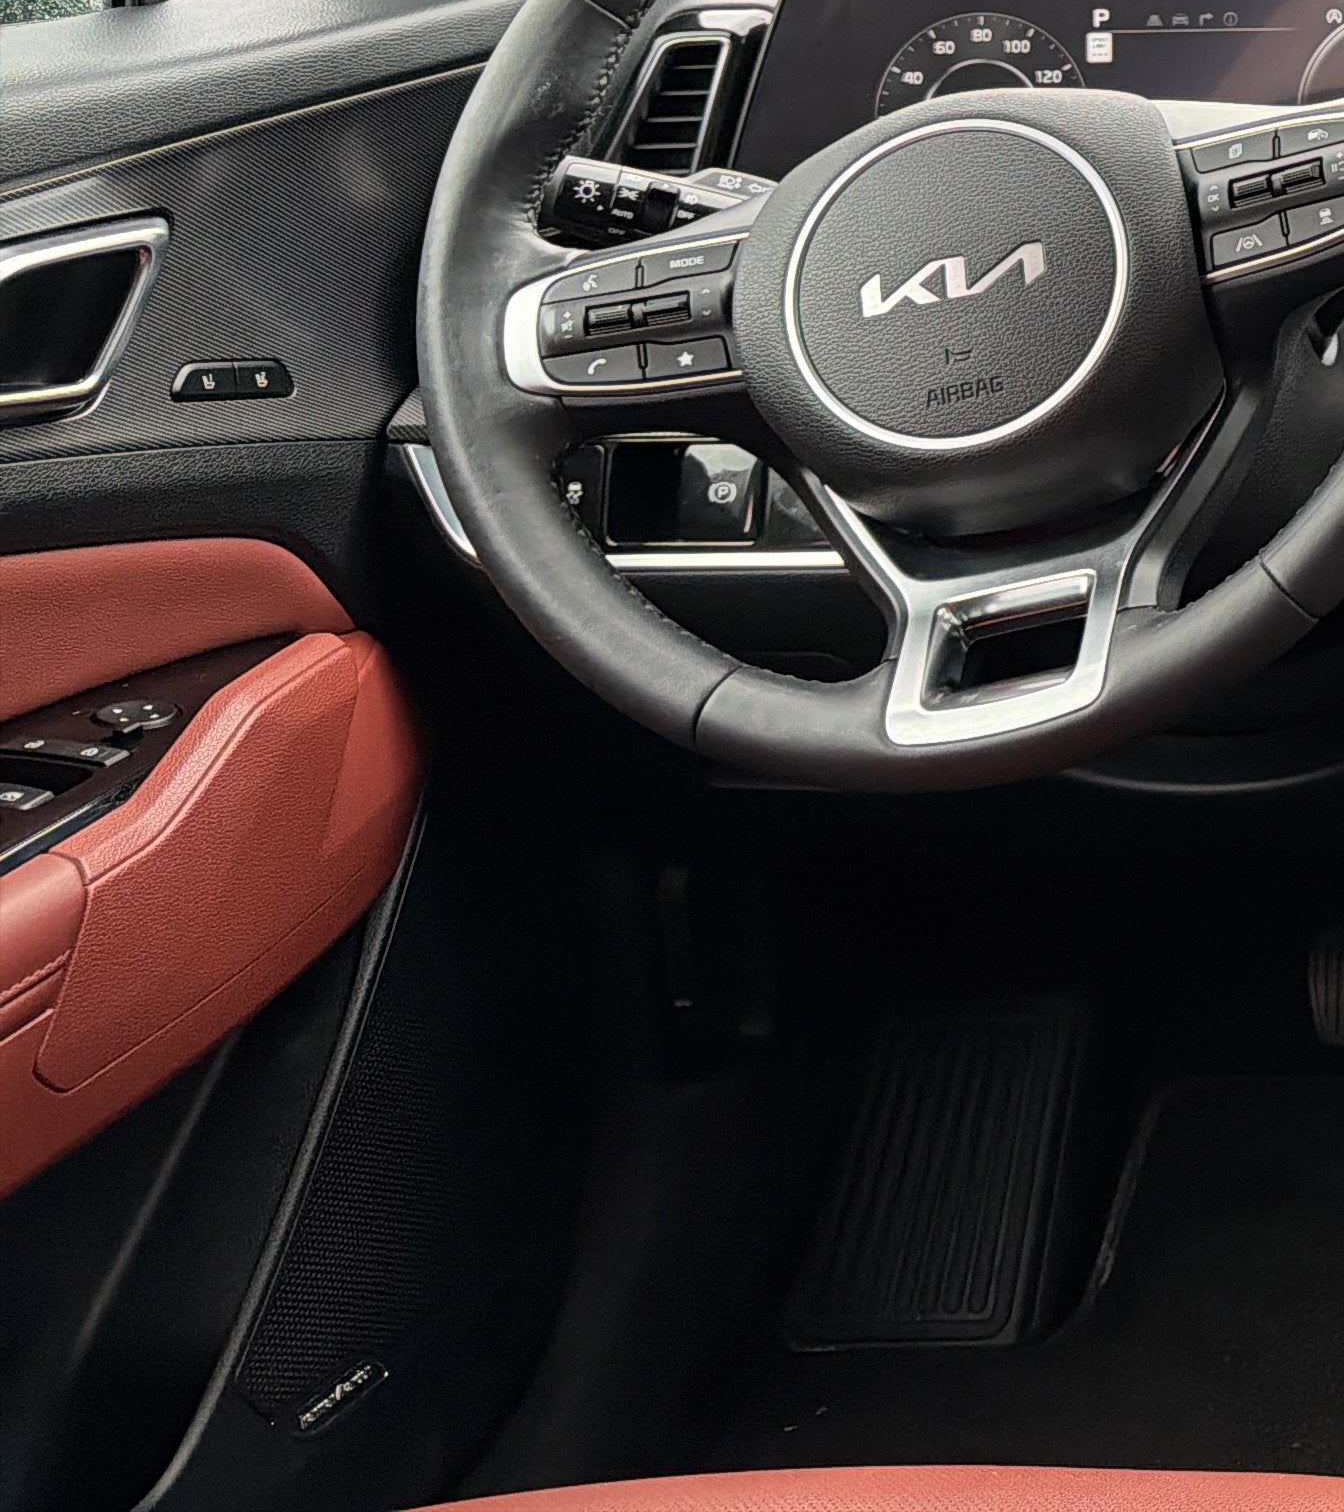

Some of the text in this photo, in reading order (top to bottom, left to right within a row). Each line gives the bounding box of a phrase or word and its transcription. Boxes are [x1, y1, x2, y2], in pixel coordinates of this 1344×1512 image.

[1092, 8, 1110, 28] P
[970, 28, 993, 43] 80
[933, 40, 956, 55] 60
[1003, 40, 1031, 54] 100
[901, 71, 924, 85] 40
[1034, 70, 1063, 84] 120
[611, 208, 634, 220] AUTO
[669, 255, 705, 269] MODE
[859, 240, 1046, 318] KIA
[925, 376, 1005, 408] AIRBAG
